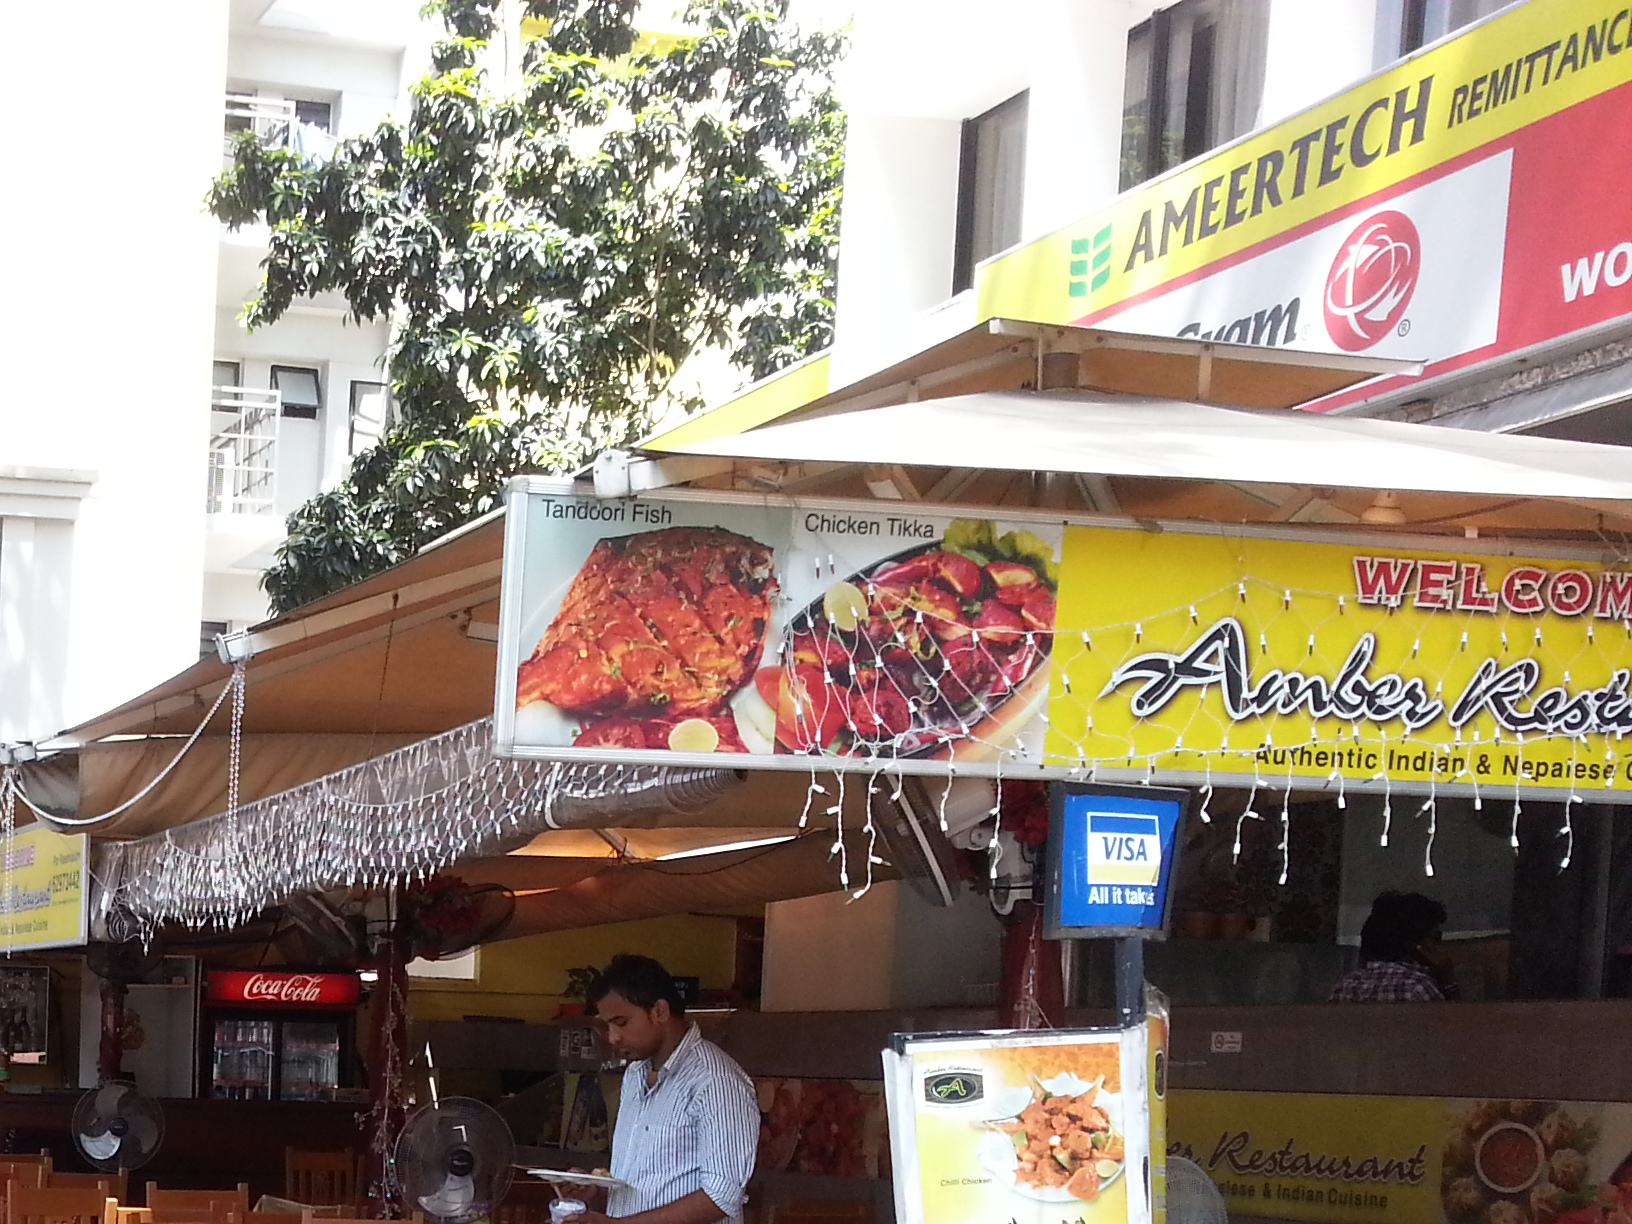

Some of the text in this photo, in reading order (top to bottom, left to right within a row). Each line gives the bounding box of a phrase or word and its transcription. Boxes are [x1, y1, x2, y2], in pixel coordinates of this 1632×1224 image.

[1122, 8, 1632, 274] AMEERTECH REMITTANC
[542, 499, 672, 525] Tandoori Fish
[805, 513, 934, 539] Chicken Tikka
[1097, 616, 1444, 730] Amber
[1254, 744, 1377, 770] Authentic
[1387, 749, 1465, 774] Indian
[1476, 754, 1491, 775] &
[1102, 836, 1148, 862] VISA
[1088, 886, 1109, 905] All
[1112, 886, 1123, 905] it
[243, 973, 325, 1002] Coca-Cola
[1206, 1130, 1428, 1185] Restaurant
[1328, 1187, 1389, 1209] Cuisine
